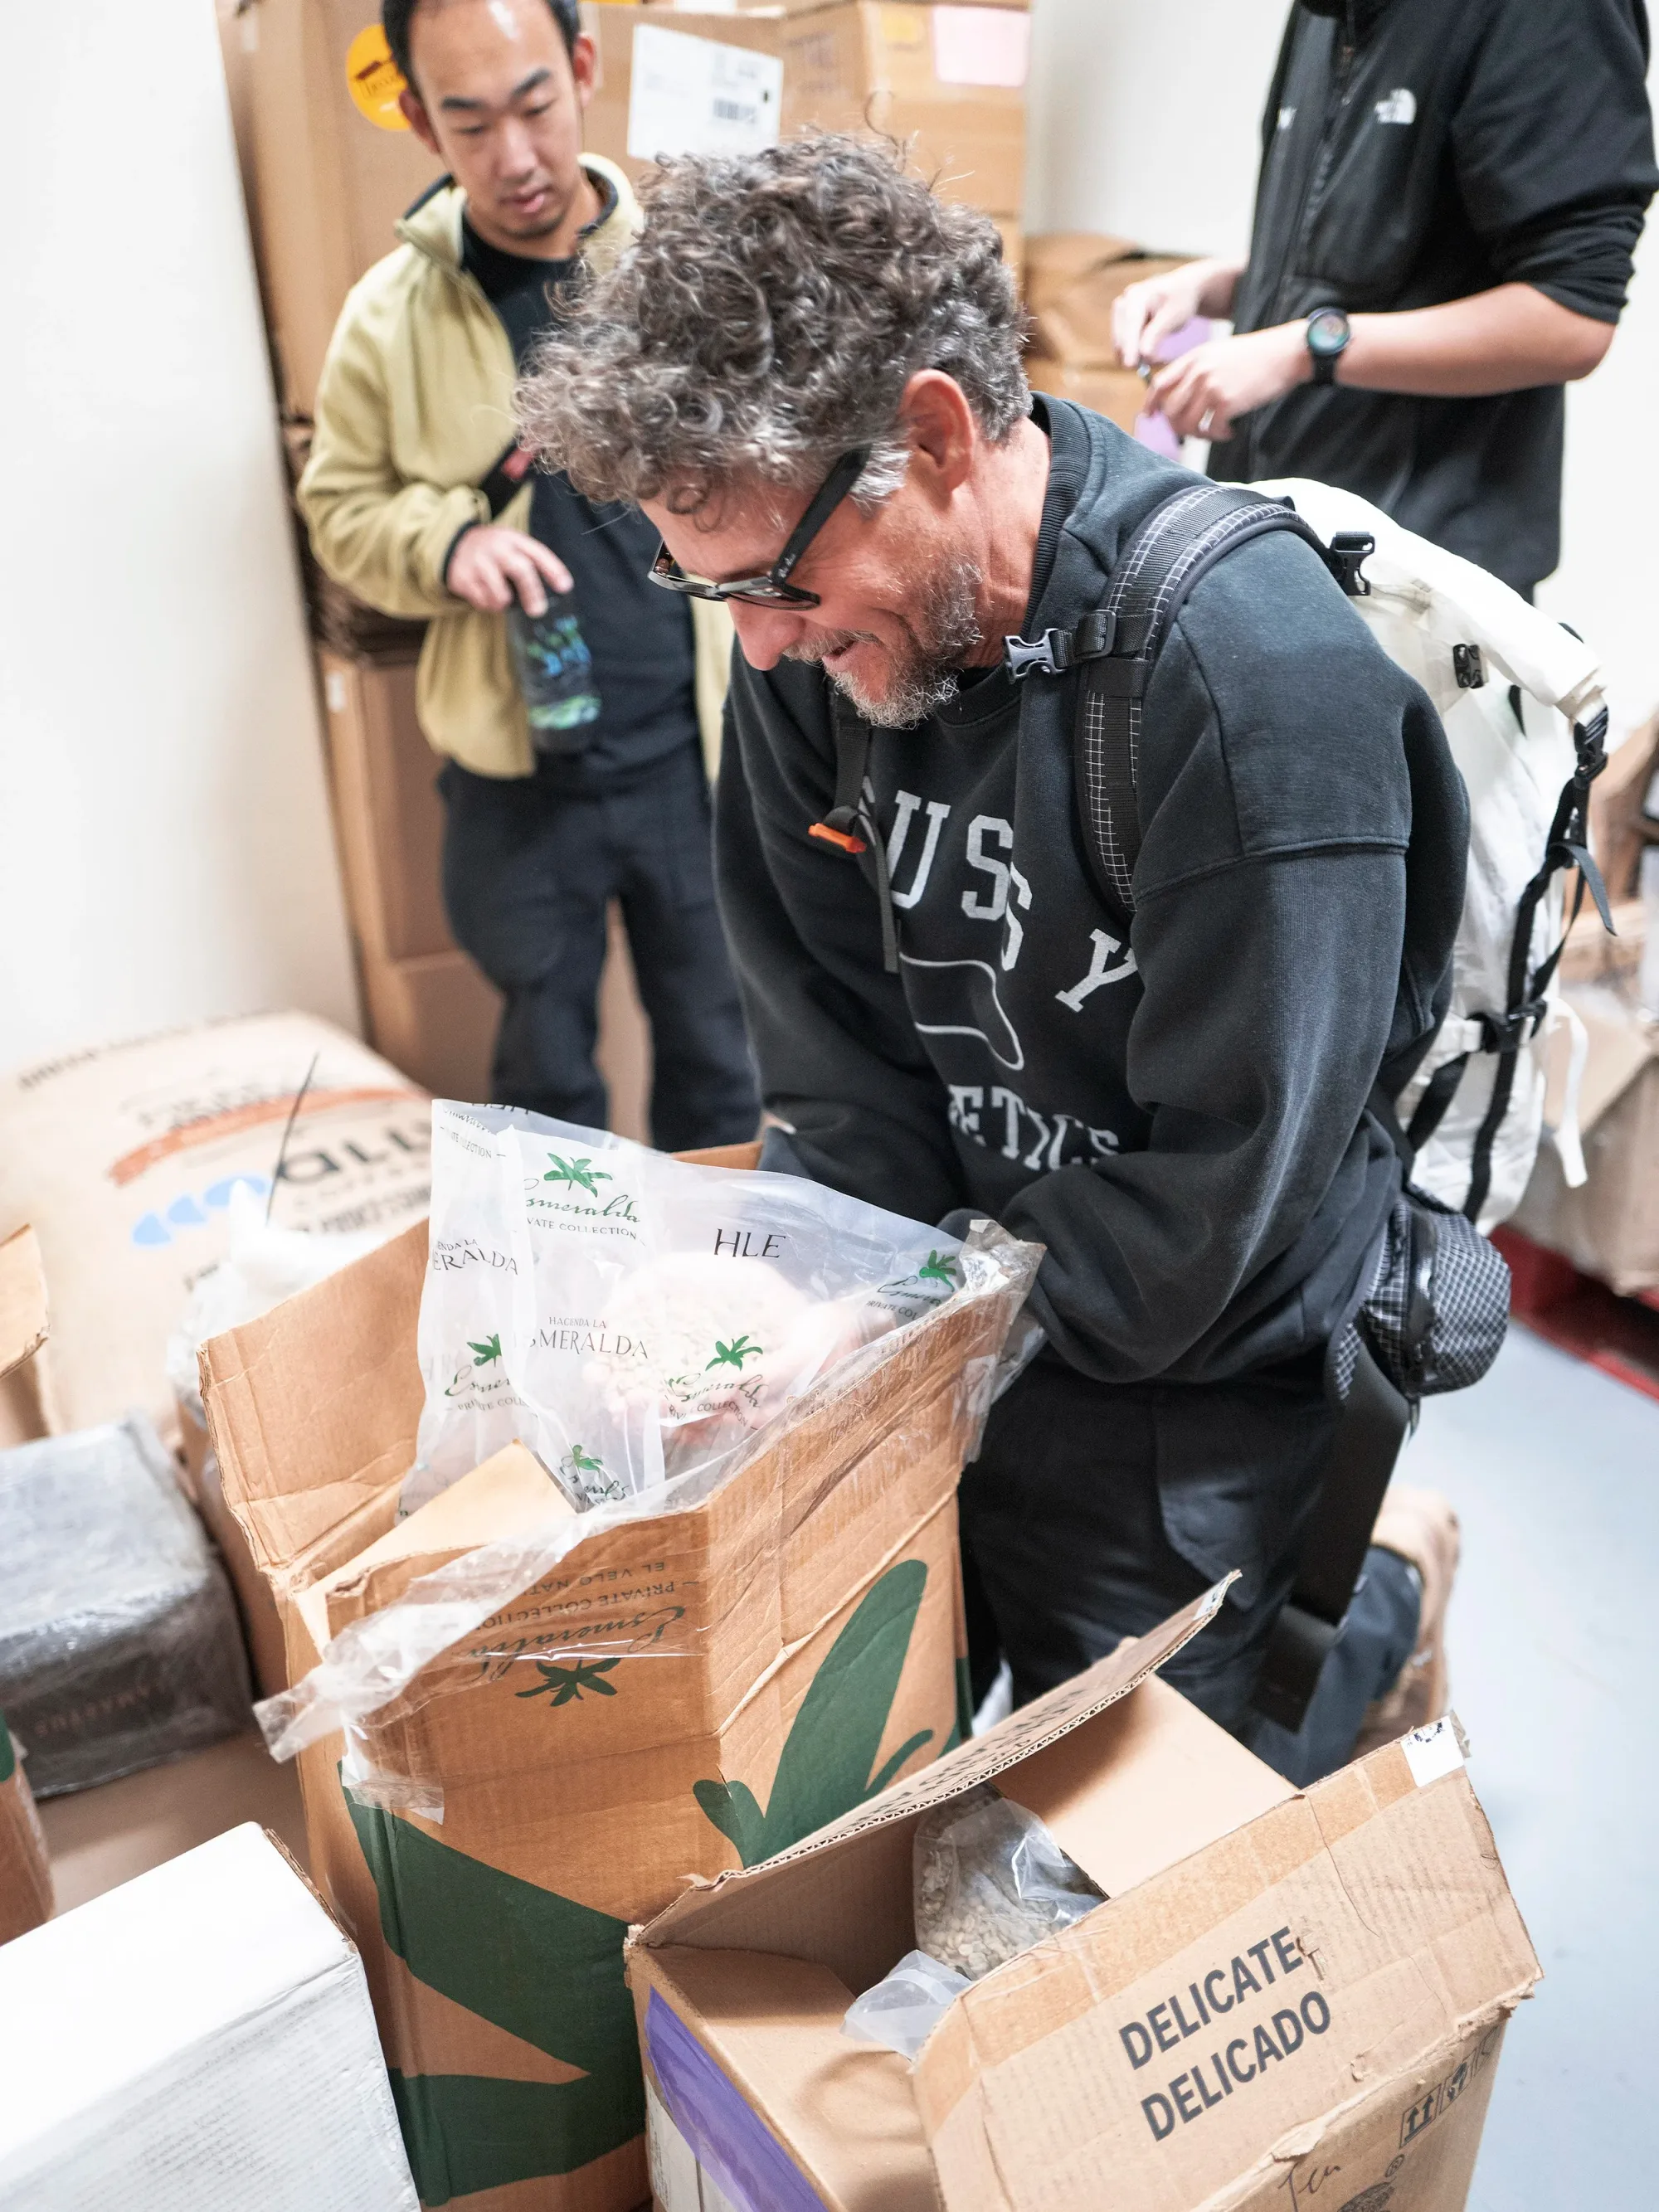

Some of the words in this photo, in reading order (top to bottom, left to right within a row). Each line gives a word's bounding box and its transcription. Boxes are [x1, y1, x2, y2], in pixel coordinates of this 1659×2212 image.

[558, 1223, 637, 1240] COLLECTION
[713, 1228, 786, 1258] HLE
[592, 1319, 607, 1329] LA
[697, 1400, 749, 1427] COLLECTION
[579, 1568, 633, 1587] VELO
[642, 1562, 664, 1572] EL
[598, 1581, 674, 1607] PRIVATE
[1118, 1926, 1304, 2070] DELICATE
[1141, 1991, 1331, 2142] DELICADO
